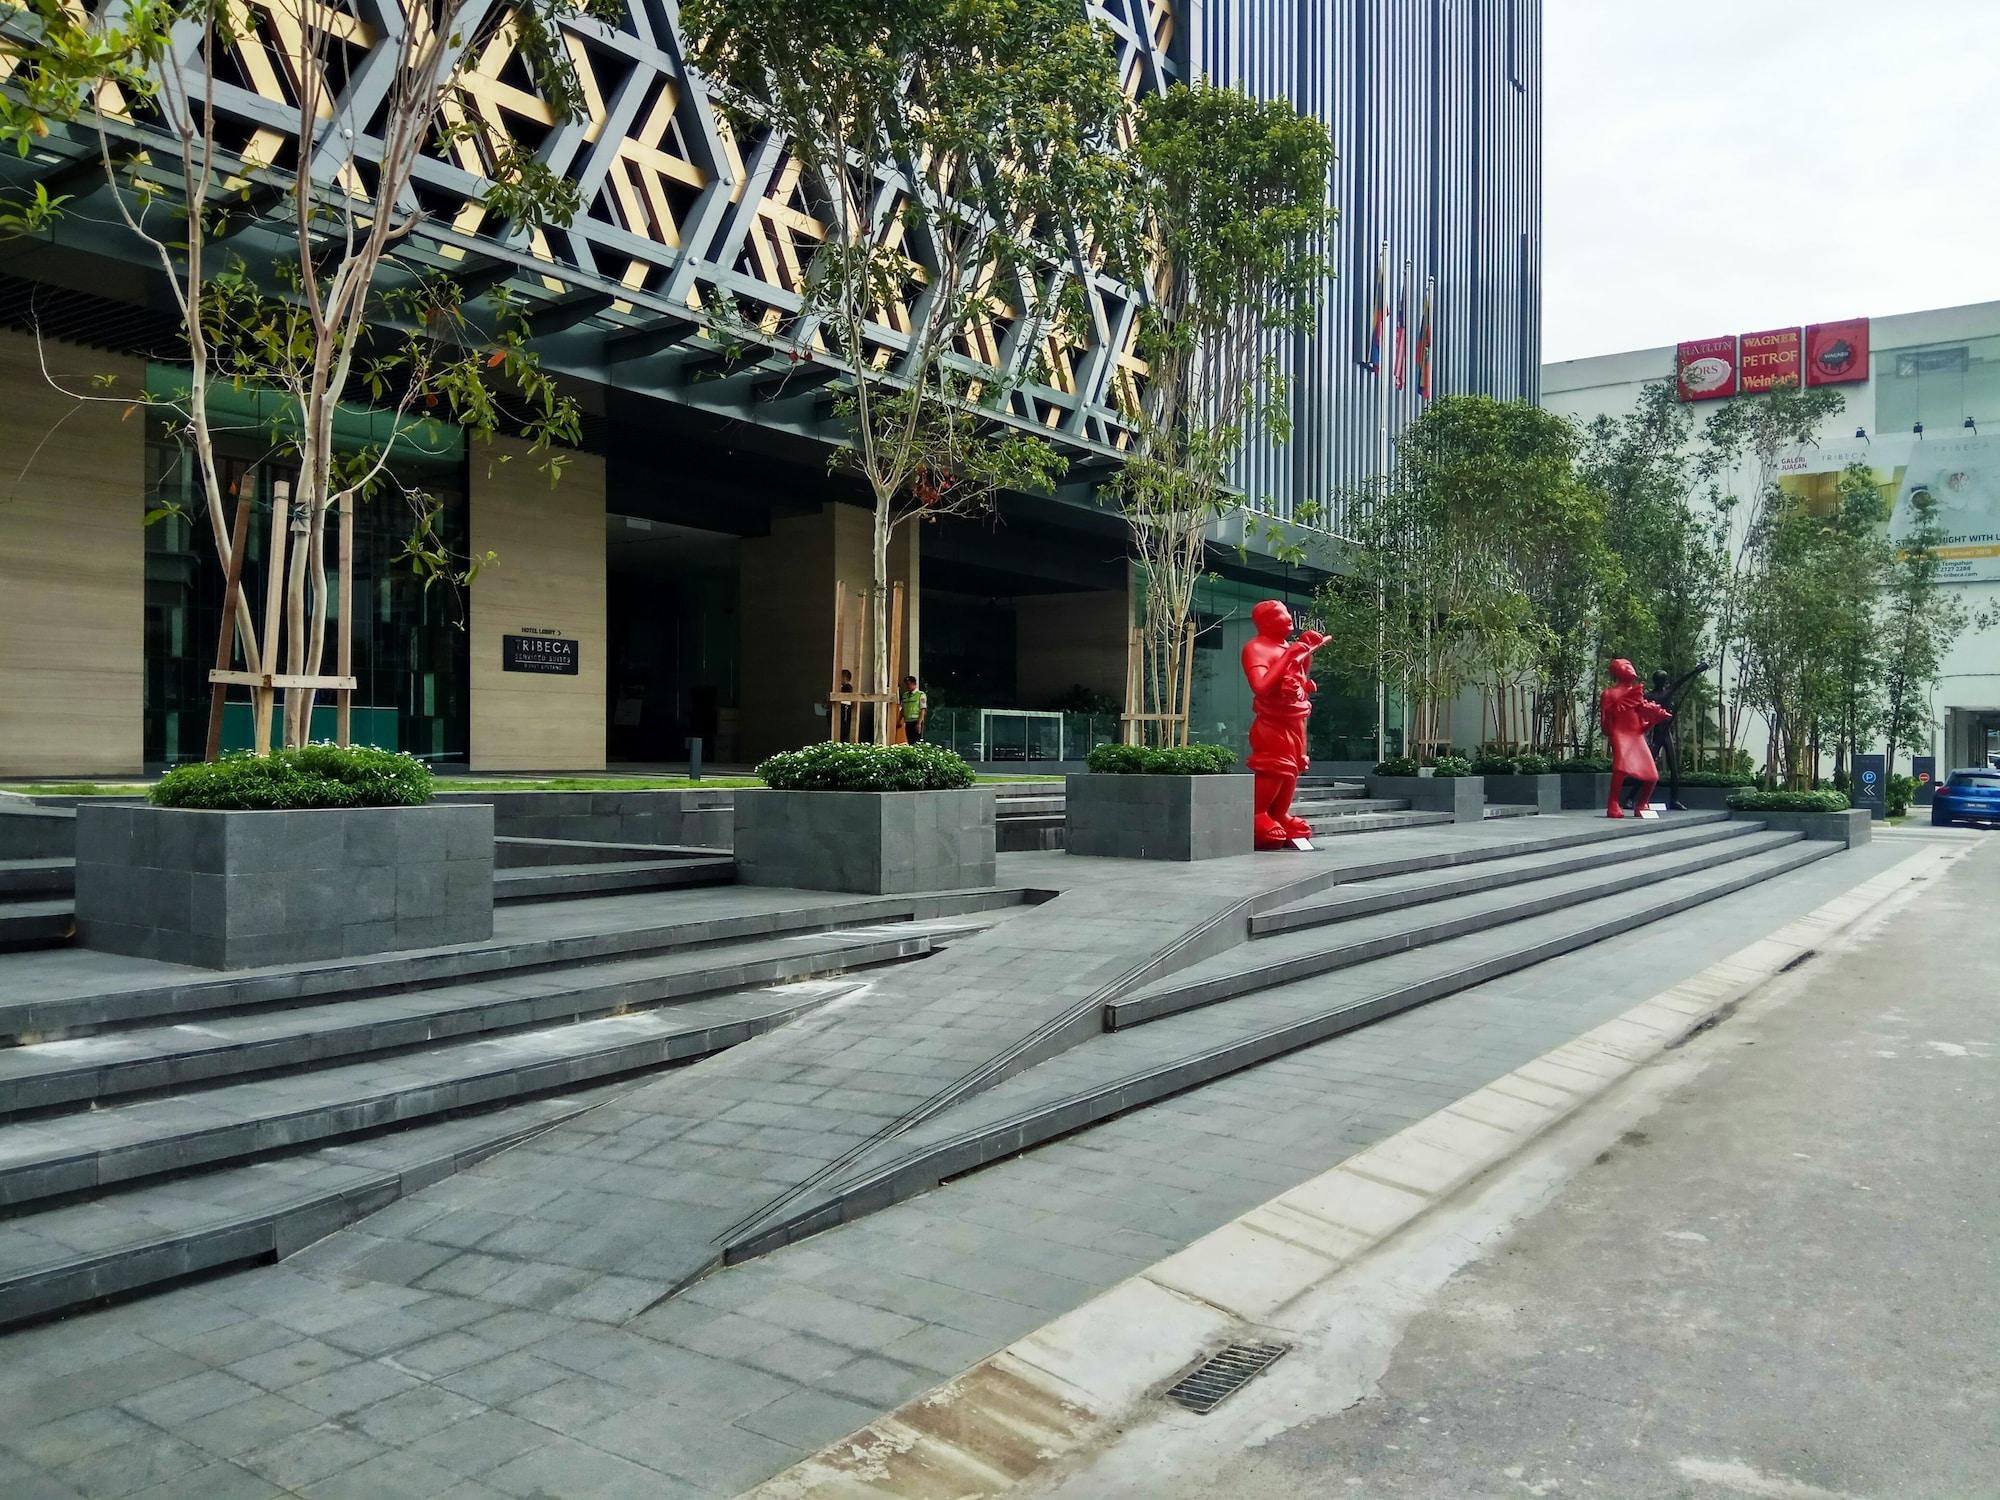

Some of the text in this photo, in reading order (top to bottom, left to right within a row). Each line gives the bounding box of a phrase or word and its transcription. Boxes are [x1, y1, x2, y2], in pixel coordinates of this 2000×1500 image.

[1743, 332, 1797, 347] WAGNER
[1743, 350, 1797, 368] PETROF
[1781, 456, 1806, 464] GALERI
[1822, 452, 1867, 461] TRIBECA
[1781, 463, 1807, 471] JUALAN
[1969, 533, 1993, 542] WITH
[514, 639, 571, 654] TRIBECA
